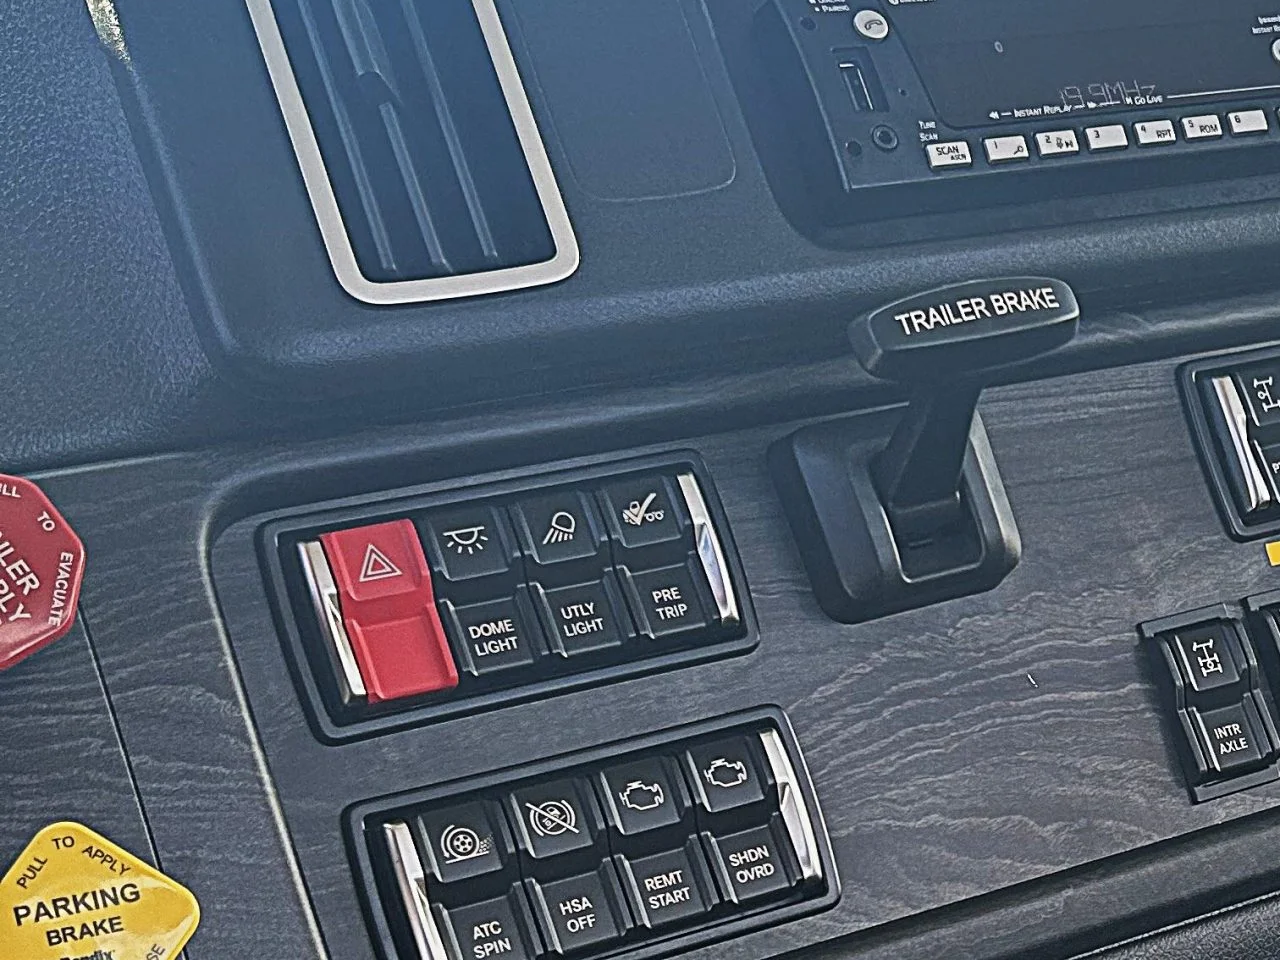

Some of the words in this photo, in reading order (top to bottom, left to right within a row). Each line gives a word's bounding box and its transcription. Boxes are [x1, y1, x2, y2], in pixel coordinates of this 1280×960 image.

[1014, 108, 1042, 118] INSTANT
[1234, 115, 1242, 124] 6
[1140, 124, 1147, 133] 4
[1188, 119, 1194, 128] 5
[1045, 134, 1052, 144] 2
[1094, 130, 1100, 138] 3
[1156, 129, 1173, 140] RPT
[936, 145, 960, 156] SCAN
[894, 297, 992, 336] TRAILER
[989, 287, 1060, 315] BRAKE
[36, 510, 56, 532] TO
[48, 552, 74, 627] EVACUATE
[652, 587, 682, 604] PRE
[560, 602, 595, 620] UTLY
[656, 603, 688, 621] TRIP
[468, 618, 515, 640] DOME
[564, 618, 604, 638] LIGHT
[474, 636, 518, 657] LIGHT
[1213, 723, 1242, 740] INTR
[1220, 737, 1248, 756] AXLE
[16, 856, 48, 890] PULL
[51, 836, 75, 850] TO
[82, 845, 132, 876] APPLY
[728, 845, 770, 867] SHDN
[644, 870, 682, 891] REMT
[736, 863, 775, 884] OVRD
[13, 883, 140, 927] PARKING
[559, 896, 594, 916] HSA
[648, 887, 690, 910] START
[46, 916, 124, 946] BRAKE
[473, 921, 502, 940] ATC
[566, 914, 596, 933] OFF
[473, 938, 512, 959] SPIN
